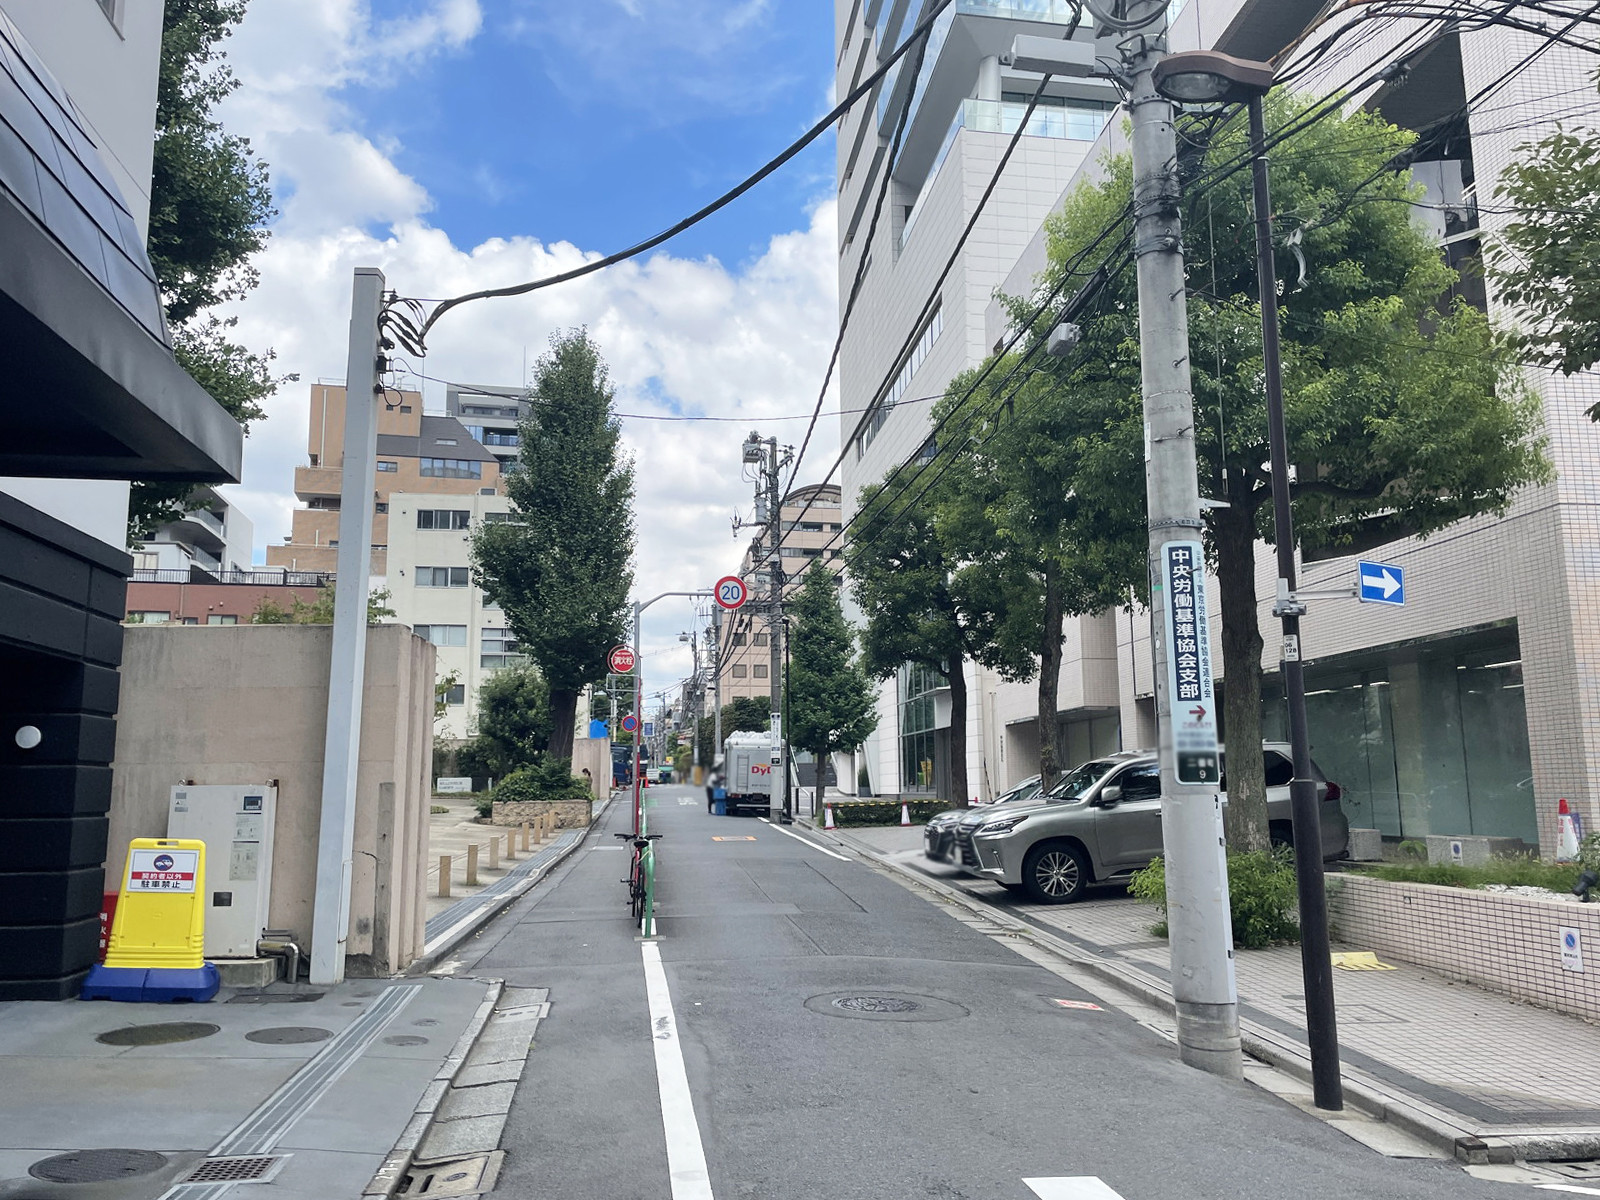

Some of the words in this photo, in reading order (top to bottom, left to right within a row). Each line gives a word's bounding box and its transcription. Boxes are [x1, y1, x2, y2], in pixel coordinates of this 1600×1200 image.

[722, 585, 740, 600] 20
[1171, 549, 1199, 699] 中央労働基準協会支部
[614, 656, 634, 666] 消火栓
[1199, 769, 1207, 779] 9
[141, 872, 182, 880] 契約者以外
[140, 880, 181, 889] 駐車禁止
